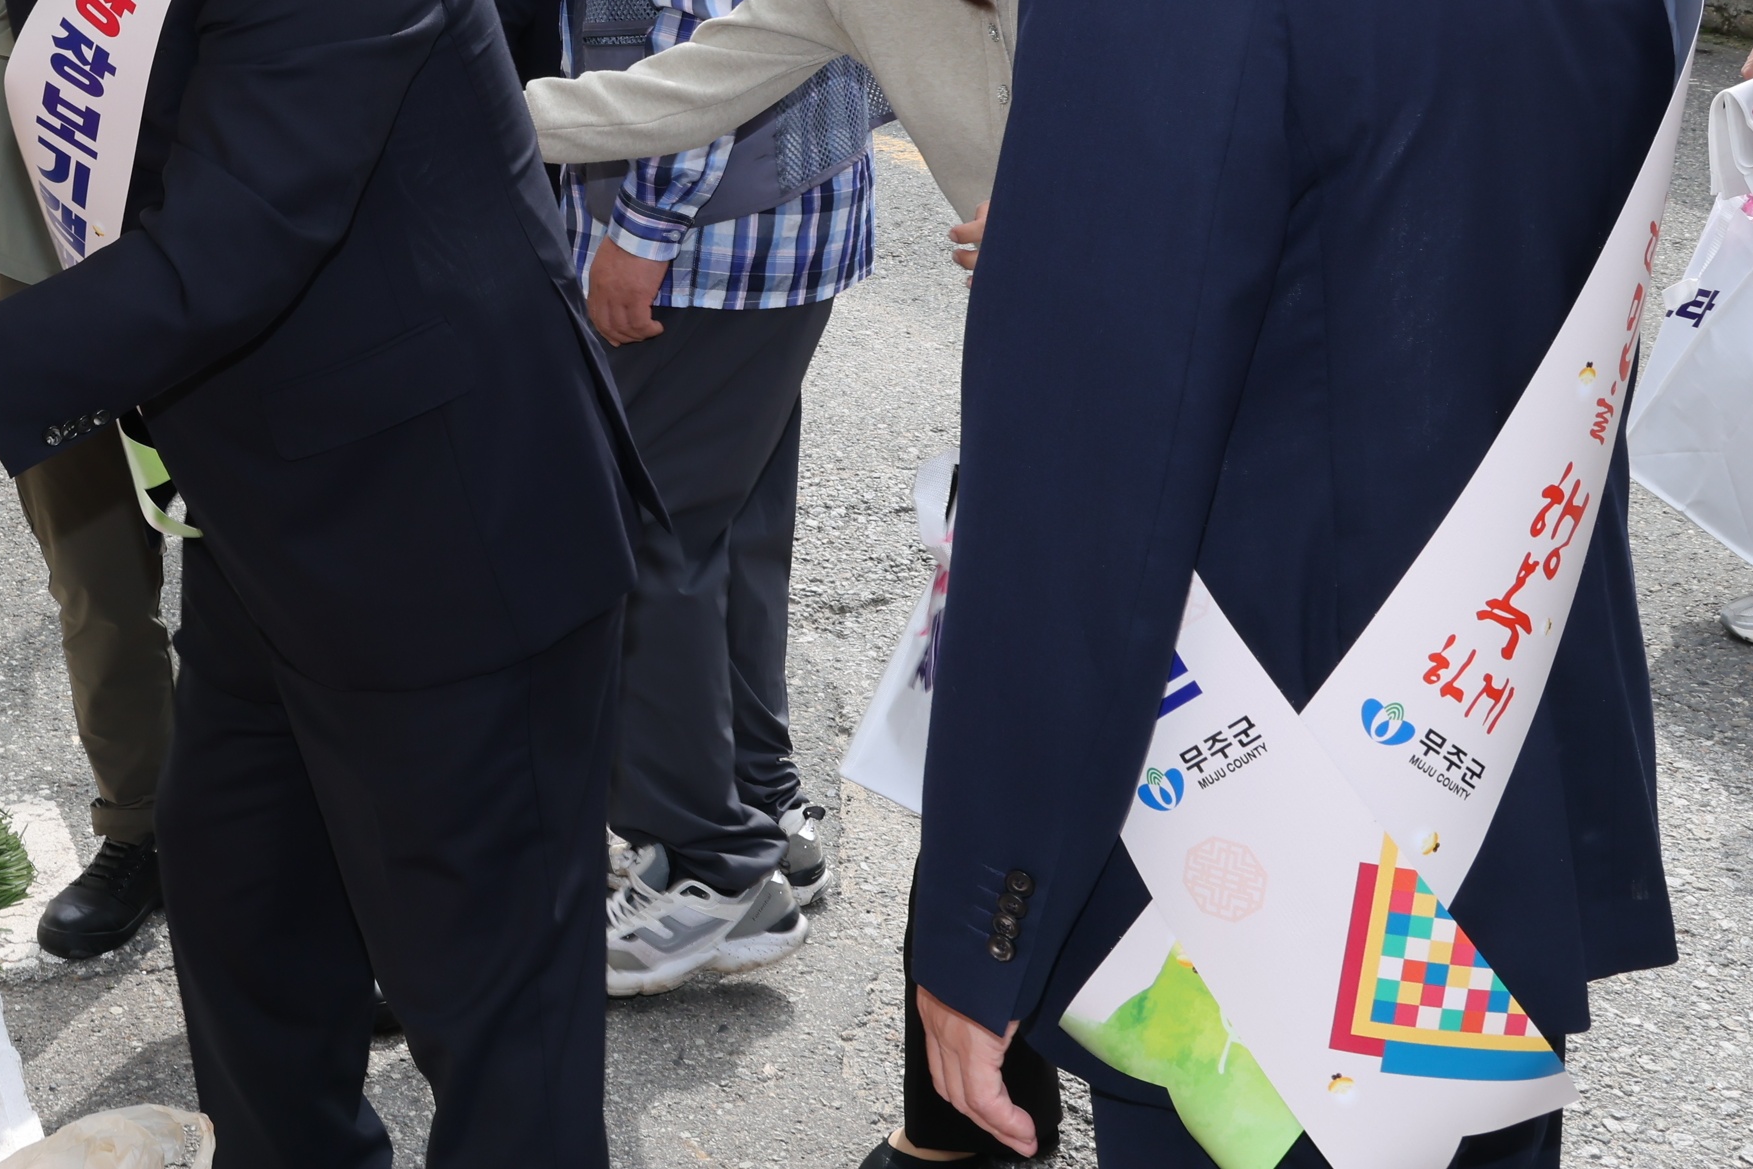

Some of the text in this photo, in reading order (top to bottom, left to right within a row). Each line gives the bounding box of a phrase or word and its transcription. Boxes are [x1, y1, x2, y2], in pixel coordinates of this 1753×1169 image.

[1422, 461, 1590, 735] 행복하게
[1179, 715, 1263, 774] 무주군
[1198, 742, 1269, 790] MUJU COUNTY
[1418, 728, 1486, 790] 무주군
[1409, 755, 1471, 801] MUJU COUNTY
